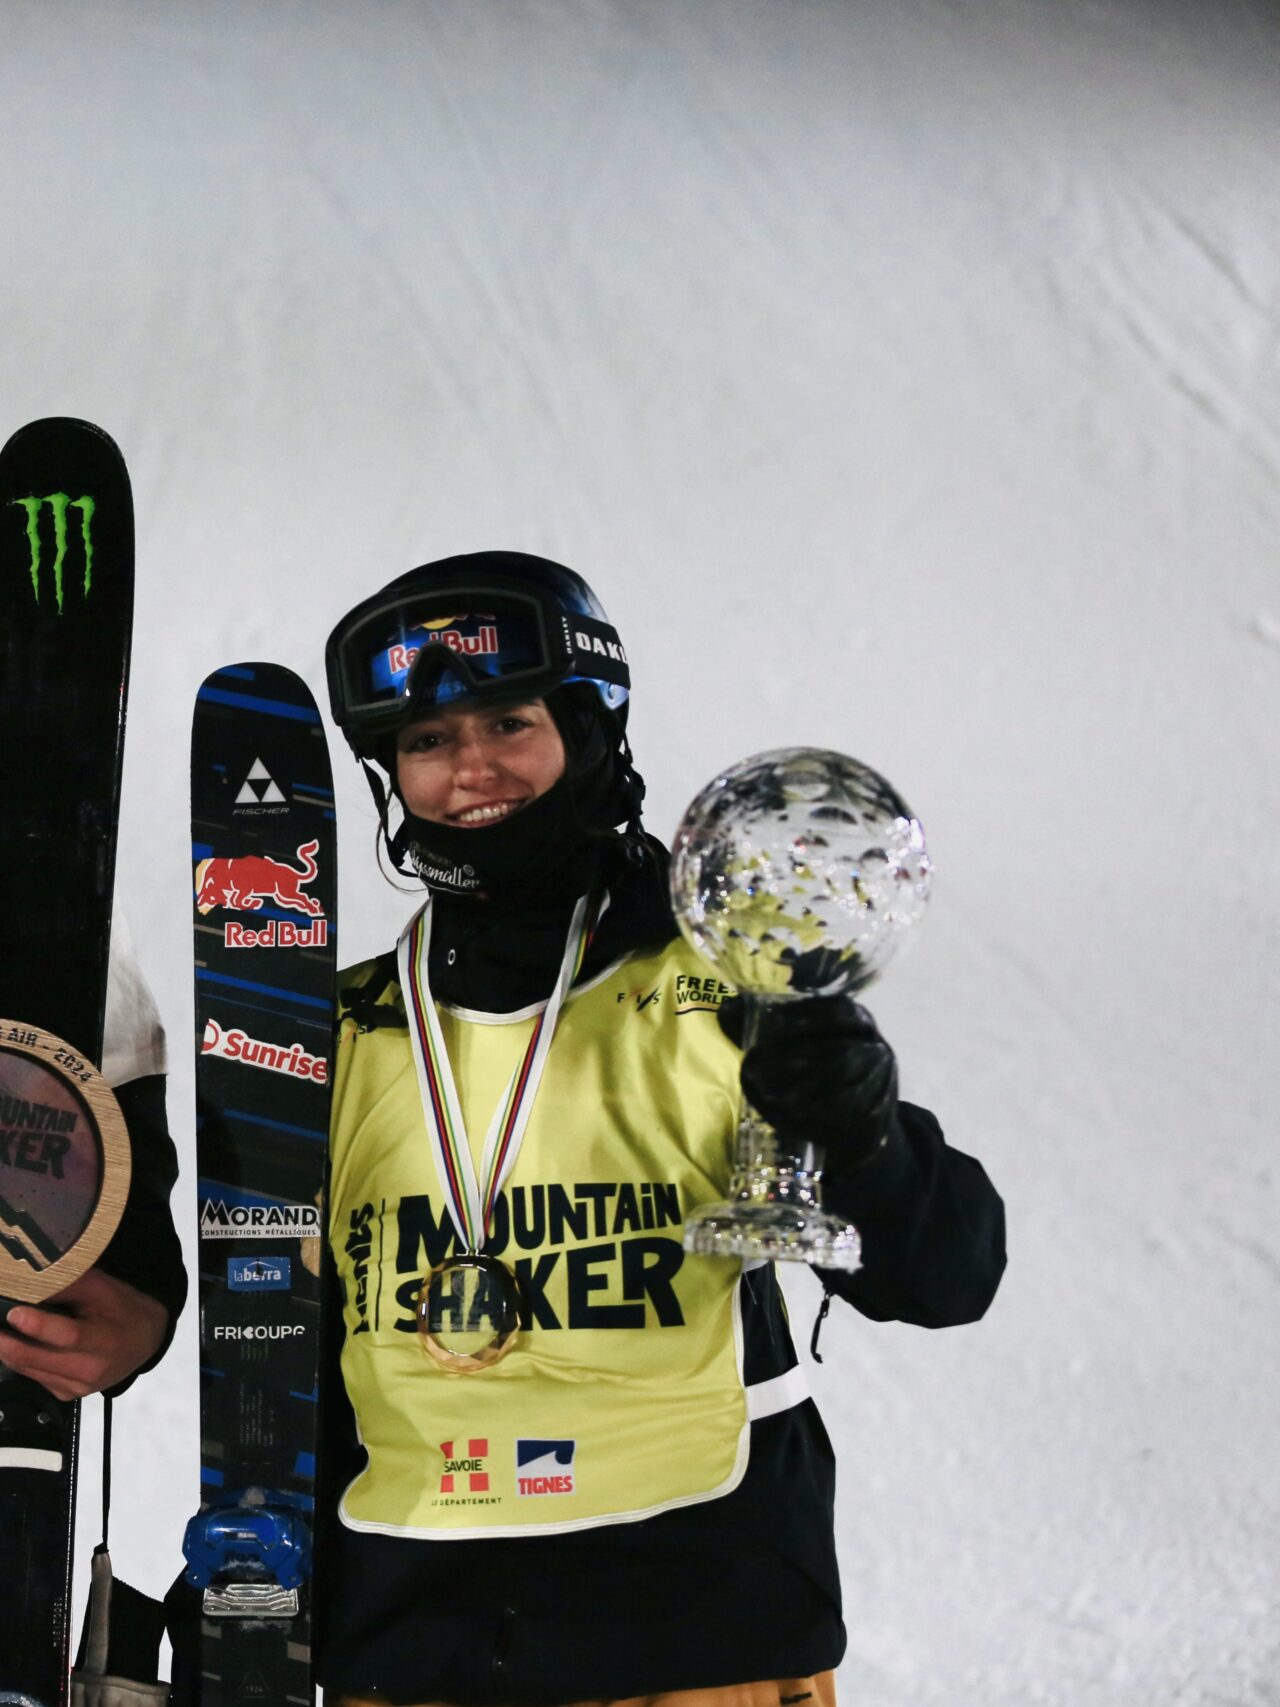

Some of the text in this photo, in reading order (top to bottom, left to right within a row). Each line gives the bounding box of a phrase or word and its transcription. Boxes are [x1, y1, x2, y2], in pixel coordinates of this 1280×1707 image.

[388, 626, 498, 674] Re Bull
[232, 807, 290, 815] FISCHER
[225, 919, 327, 947] Red Bull
[617, 989, 661, 1008] FIS
[7, 1028, 38, 1047] AIR
[53, 1047, 93, 1084] 2024
[223, 1032, 327, 1080] Sunrise
[202, 1199, 318, 1226] MORAND
[396, 1182, 682, 1275] MOUNTAIN
[394, 1236, 686, 1334] SHAKER
[444, 1459, 482, 1472] SAVOIE
[518, 1475, 573, 1495] TIGNES
